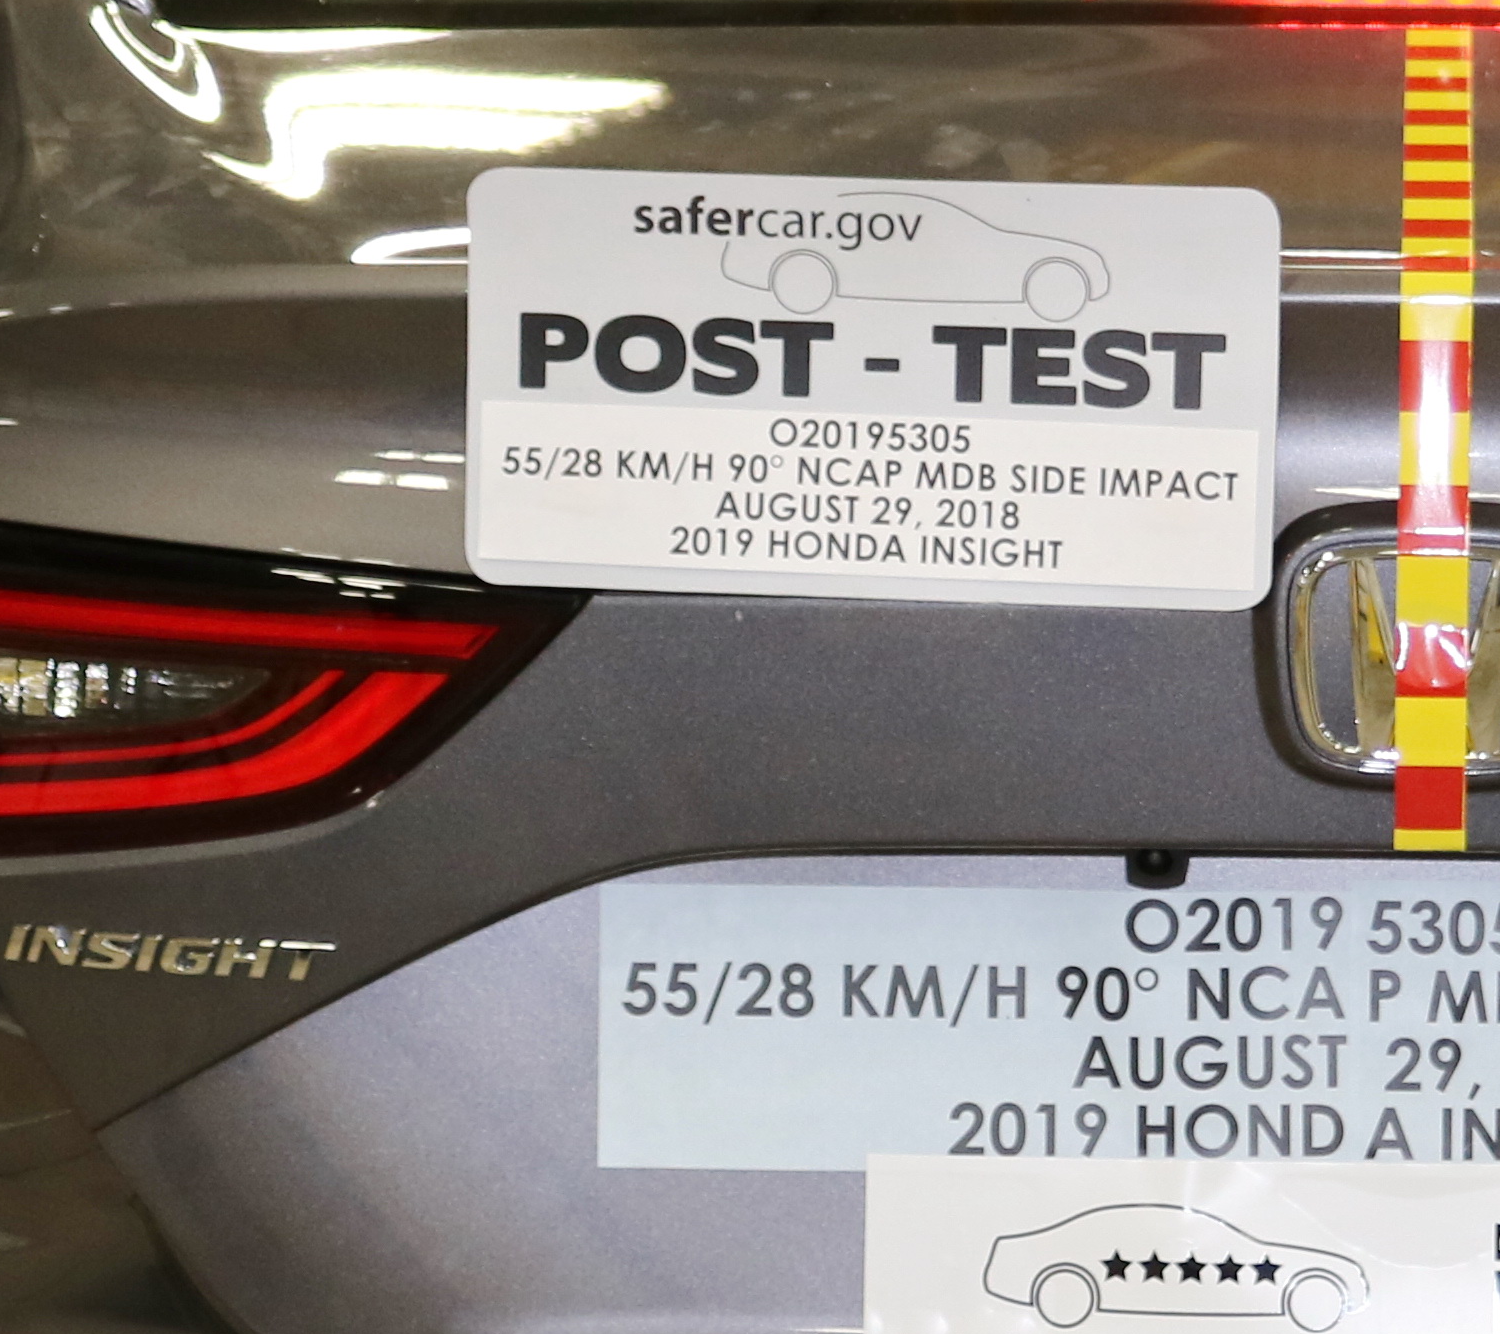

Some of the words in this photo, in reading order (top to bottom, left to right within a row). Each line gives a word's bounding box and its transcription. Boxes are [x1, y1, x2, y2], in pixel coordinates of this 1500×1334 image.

[633, 195, 923, 251] safercar.gov
[518, 312, 835, 398] POST
[932, 325, 1227, 410] TEST
[500, 446, 604, 481] 55/28
[616, 449, 714, 486] KM/H
[797, 456, 903, 488] NCAP
[914, 460, 997, 492] MDB
[1009, 463, 1087, 496] SIDE
[1099, 467, 1240, 501] IMPACT
[714, 490, 860, 524] AUGUST
[873, 496, 923, 531] 29,
[939, 498, 1021, 531] 2018
[669, 525, 755, 557] 2019
[768, 529, 907, 564] HONDA
[920, 535, 1065, 569] INSIGHT
[5, 924, 337, 981] INSIGHT
[621, 961, 816, 1026] 55/28
[842, 963, 1028, 1028] KM/H
[1072, 1033, 1348, 1091] AUGUST
[1384, 1037, 1482, 1101] 29,
[947, 1101, 1111, 1158] 2019
